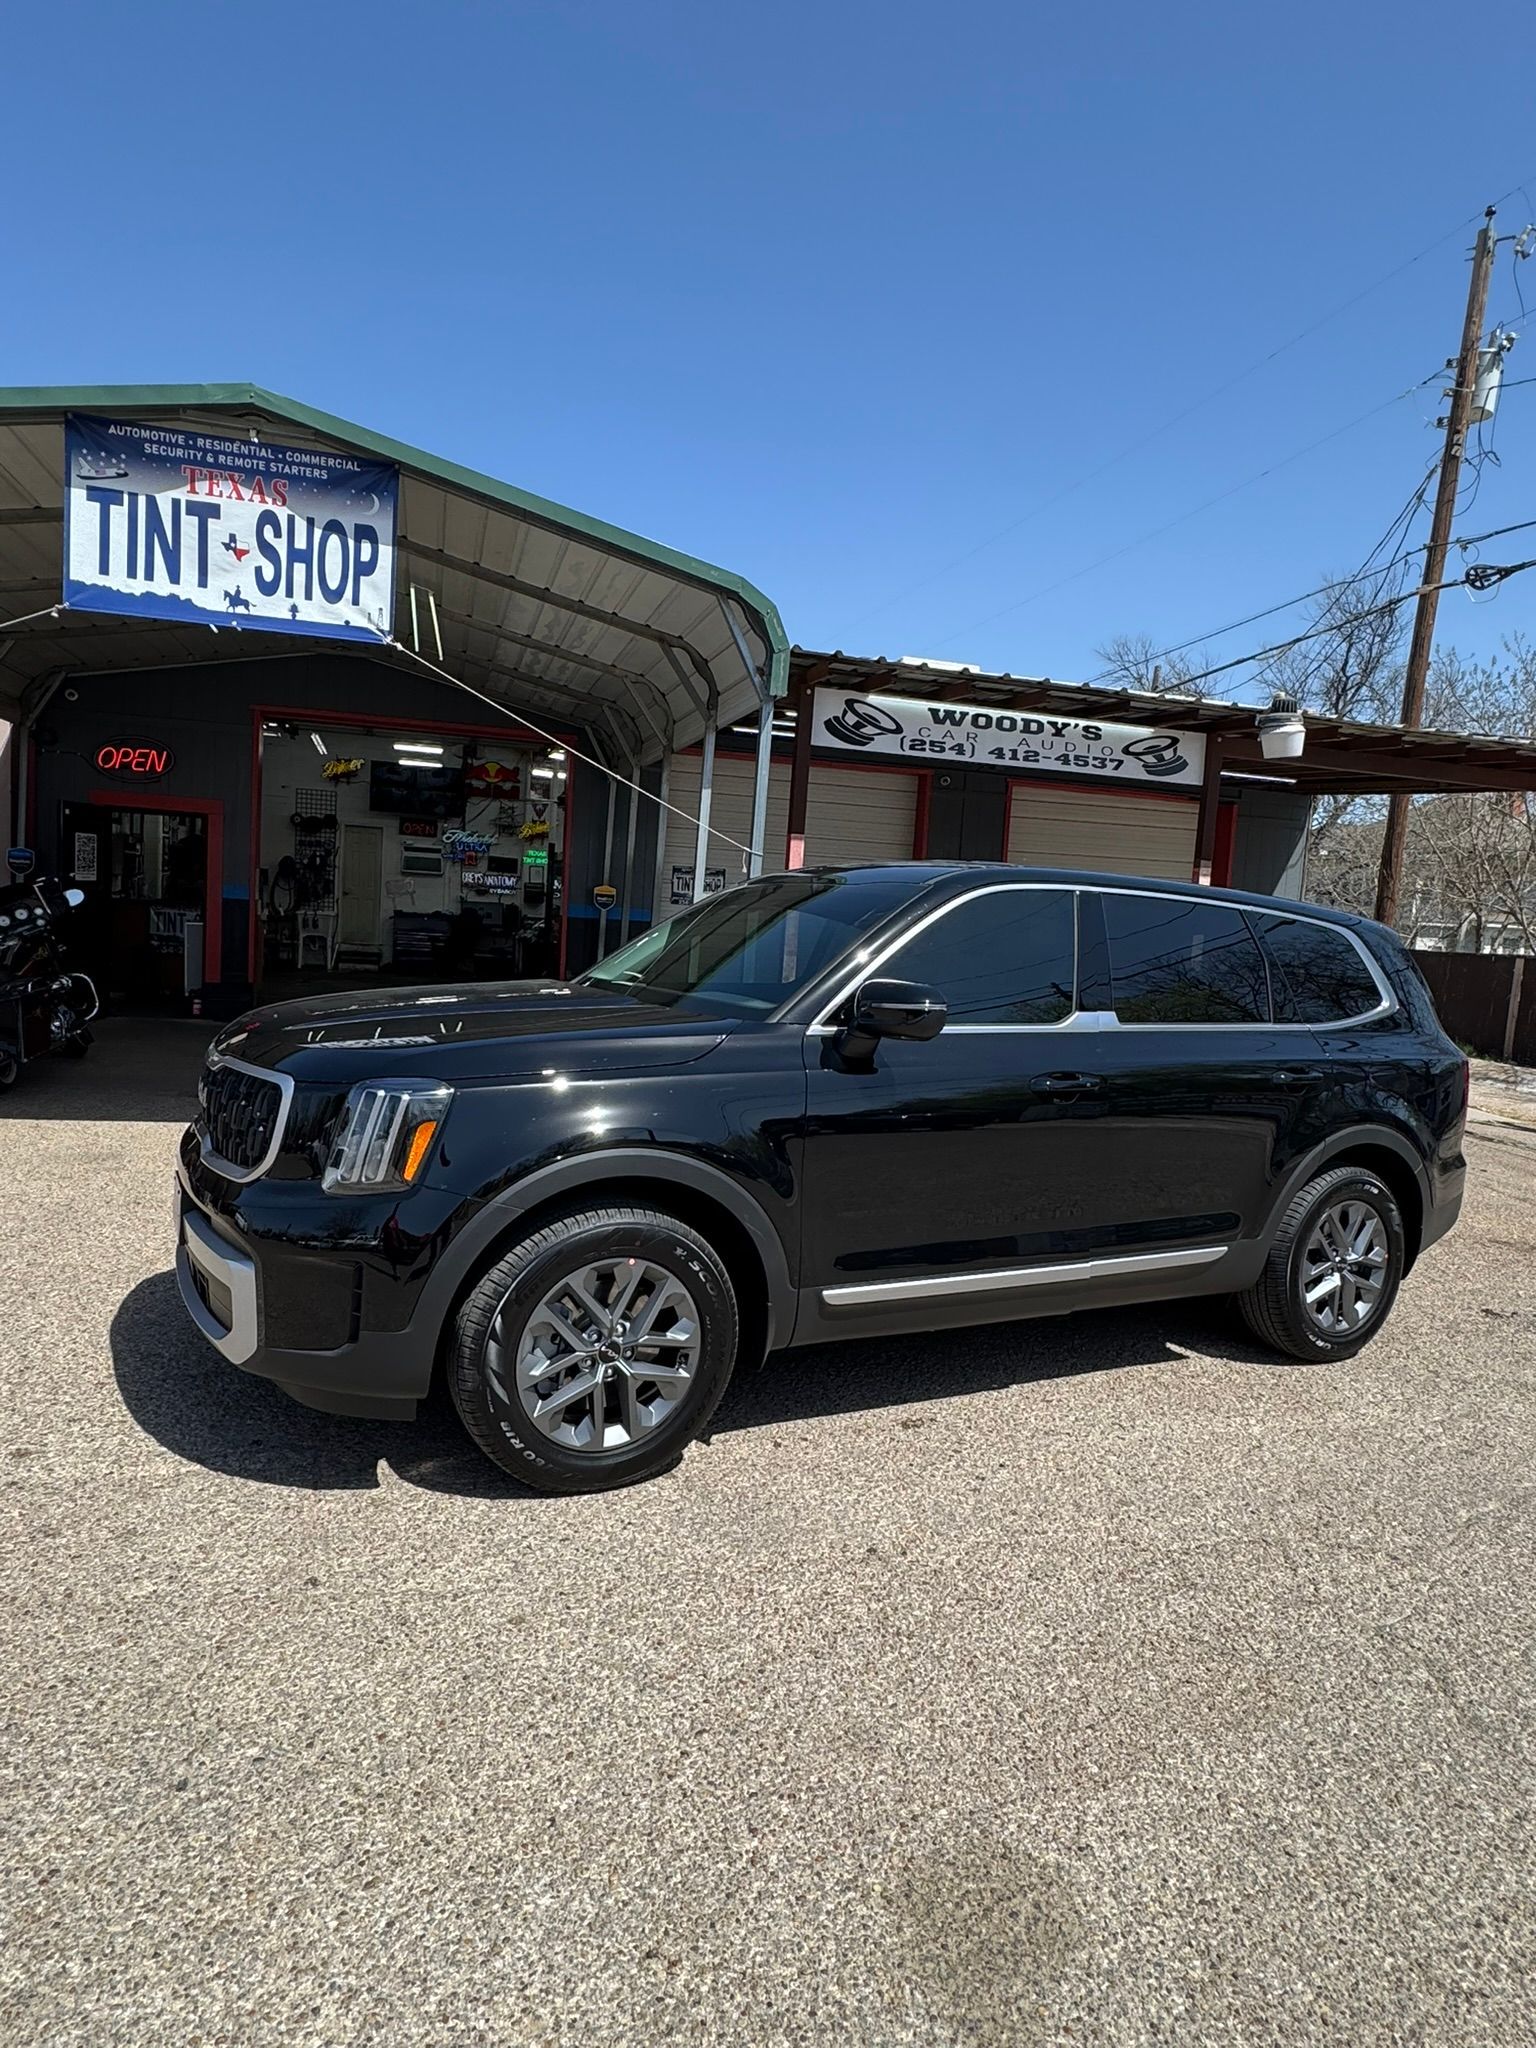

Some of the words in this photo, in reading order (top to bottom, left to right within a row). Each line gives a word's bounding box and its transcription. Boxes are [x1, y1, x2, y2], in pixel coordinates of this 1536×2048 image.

[108, 424, 185, 445] AUTOMOTIVE
[197, 438, 275, 459] RESIDENTIAL
[286, 451, 361, 471] COMMERCIAL
[144, 443, 203, 461] SECURITY
[206, 453, 215, 463] &
[218, 456, 266, 471] REMOTE
[269, 462, 328, 480] STARTERS
[181, 464, 289, 507] TEXAS
[86, 484, 221, 589] TINT
[254, 508, 380, 606] SHOP
[918, 726, 979, 743] CAR
[1017, 737, 1114, 757] AUDIO
[928, 707, 1102, 742] WOODY'S
[98, 746, 167, 772] OPEN
[900, 735, 975, 759] (254)
[988, 746, 1125, 771] 412-4537
[703, 878, 722, 892] HOP
